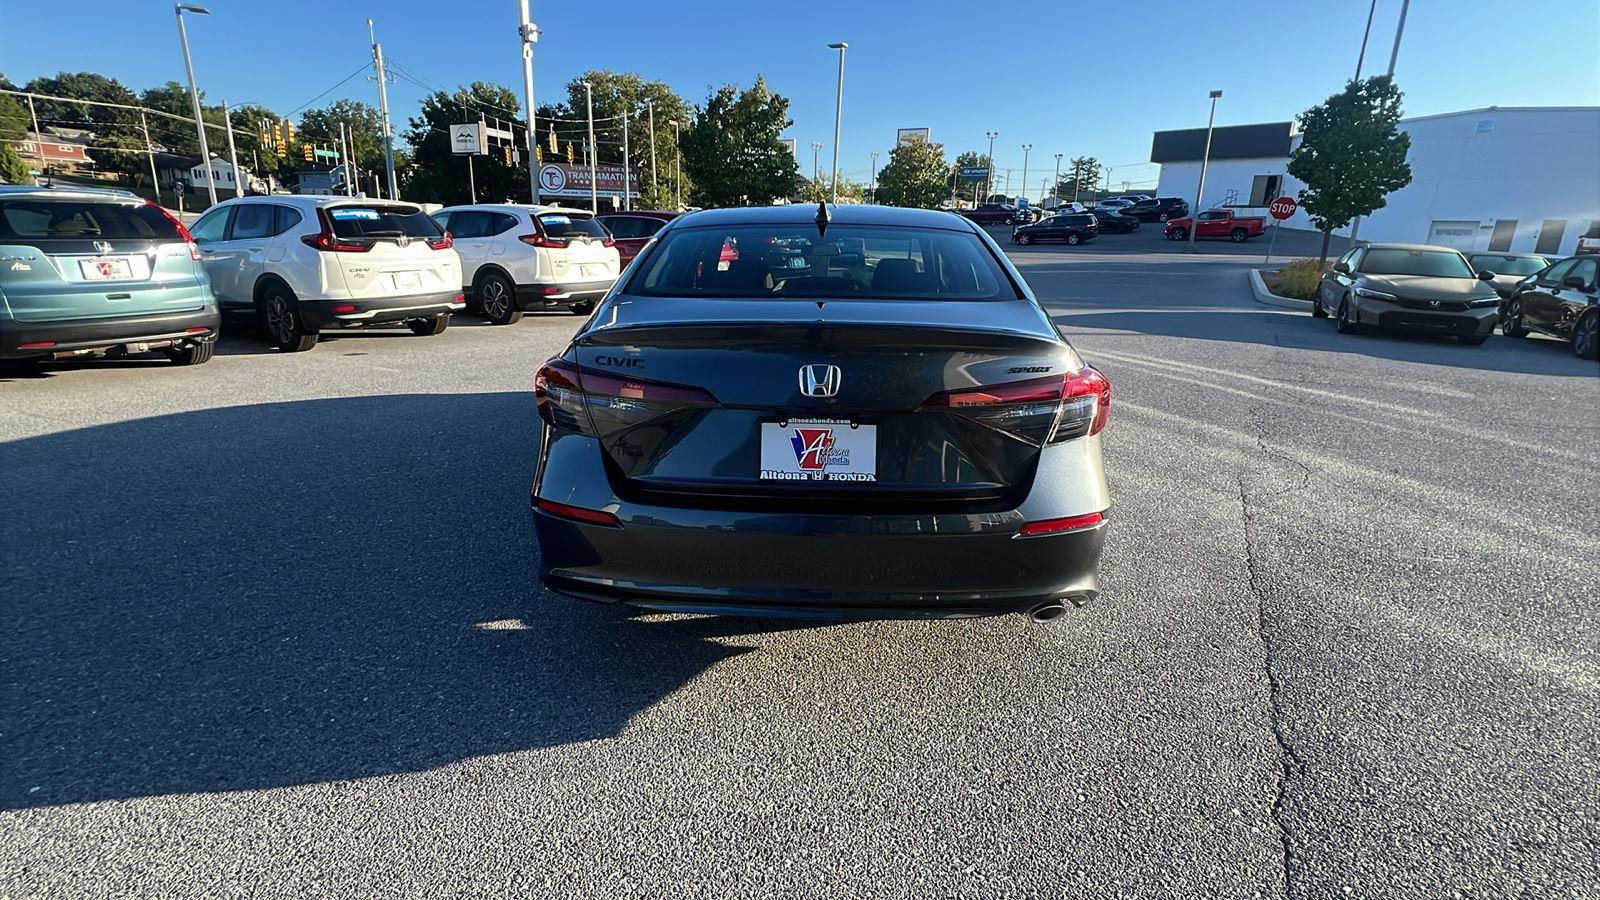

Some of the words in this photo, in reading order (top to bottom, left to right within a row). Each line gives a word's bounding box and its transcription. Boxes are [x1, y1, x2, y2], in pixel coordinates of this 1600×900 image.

[1271, 203, 1296, 214] STOP
[595, 356, 646, 369] CIVIC
[1007, 366, 1053, 374] SPORT
[760, 470, 808, 480] Altoona
[828, 472, 876, 482] HONDA
